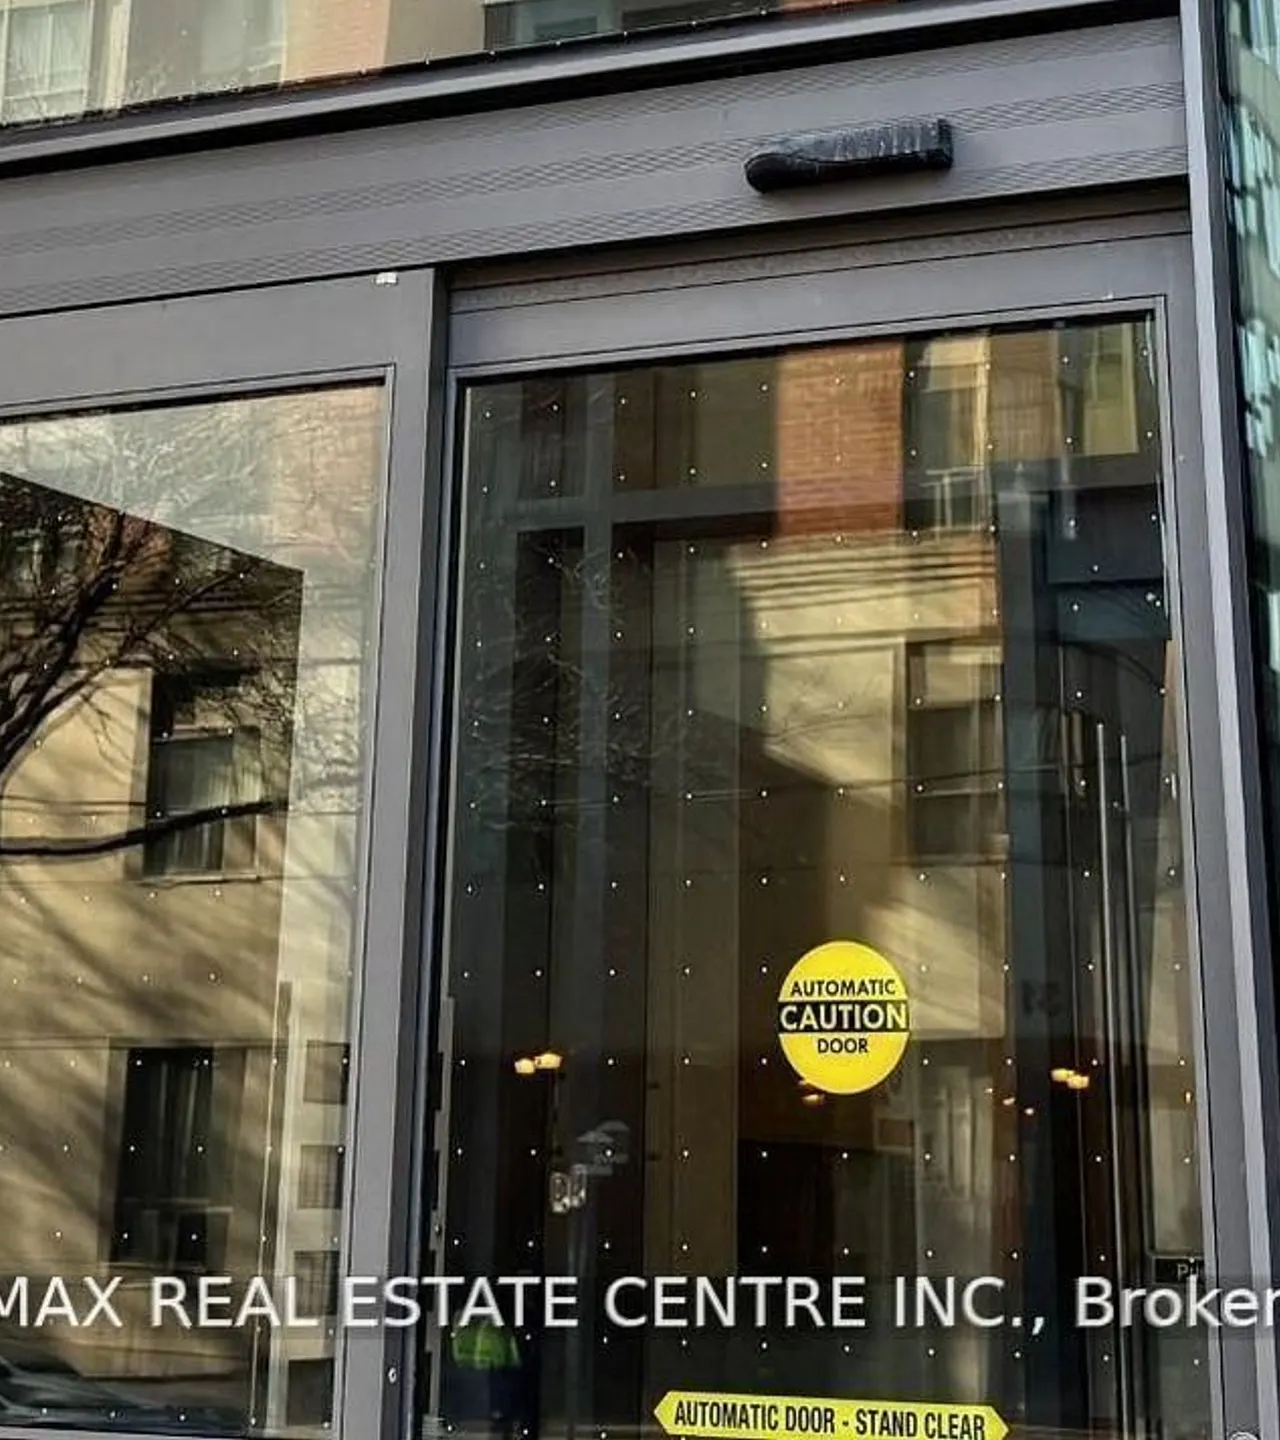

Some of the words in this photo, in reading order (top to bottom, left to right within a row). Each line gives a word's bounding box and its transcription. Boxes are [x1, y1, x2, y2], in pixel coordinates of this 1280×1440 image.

[790, 978, 897, 998] AUTOMATIC
[779, 1003, 908, 1031] CAUTION
[817, 1037, 870, 1055] DOOR
[674, 1400, 779, 1432] AUTOMATIC
[785, 1407, 835, 1434] DOOR
[856, 1409, 917, 1438] STAND
[924, 1413, 986, 1440] CLEAR
